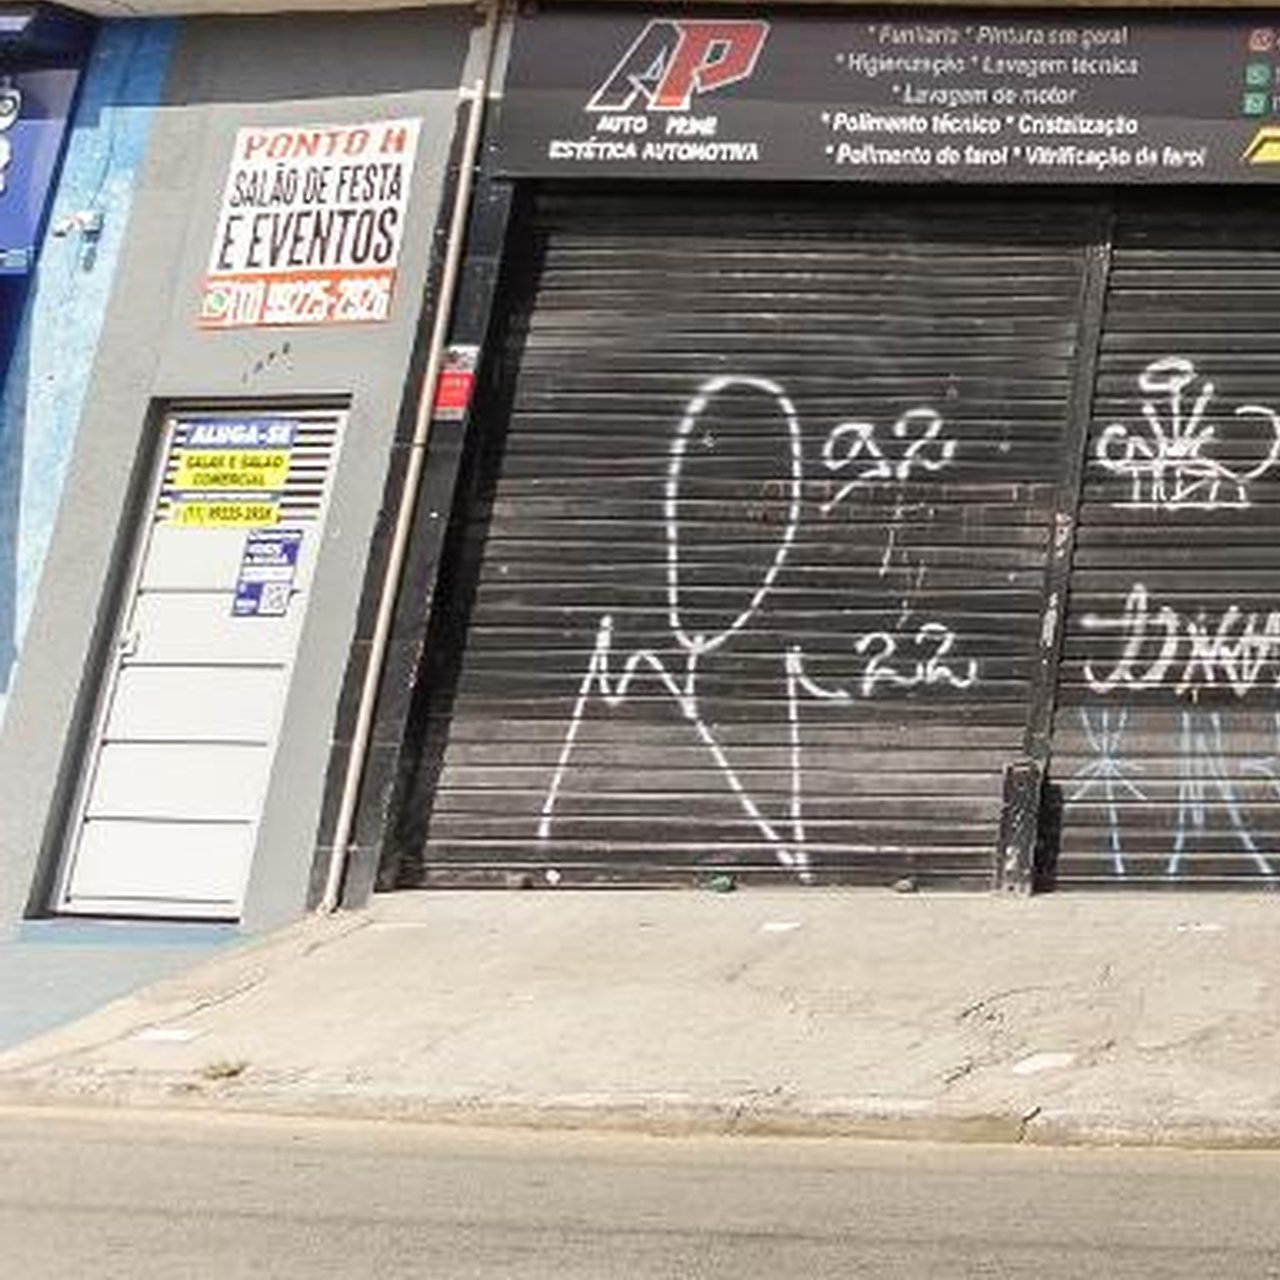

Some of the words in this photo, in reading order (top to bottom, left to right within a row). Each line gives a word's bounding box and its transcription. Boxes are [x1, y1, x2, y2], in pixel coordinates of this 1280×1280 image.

[982, 55, 1068, 78] Lavagem
[903, 83, 988, 108] Lavagem
[1020, 86, 1078, 105] motor
[596, 115, 648, 134] AUTO
[832, 111, 929, 135] Polimento
[931, 113, 1002, 135] técnico
[1017, 114, 1139, 138] Cristalização
[243, 128, 371, 160] PONTO
[641, 142, 760, 161] AUTOMOTIVA
[836, 142, 932, 166] Polimento
[963, 144, 1007, 166] farol
[1024, 144, 1131, 170] Vitrificação
[229, 162, 299, 208] SALÃO
[302, 165, 333, 205] DE
[335, 162, 402, 202] FESTA
[215, 215, 244, 270] E
[245, 206, 399, 269] EVENTOS
[188, 423, 293, 445] ALUGA-SE
[193, 473, 265, 486] COMERCIAL
